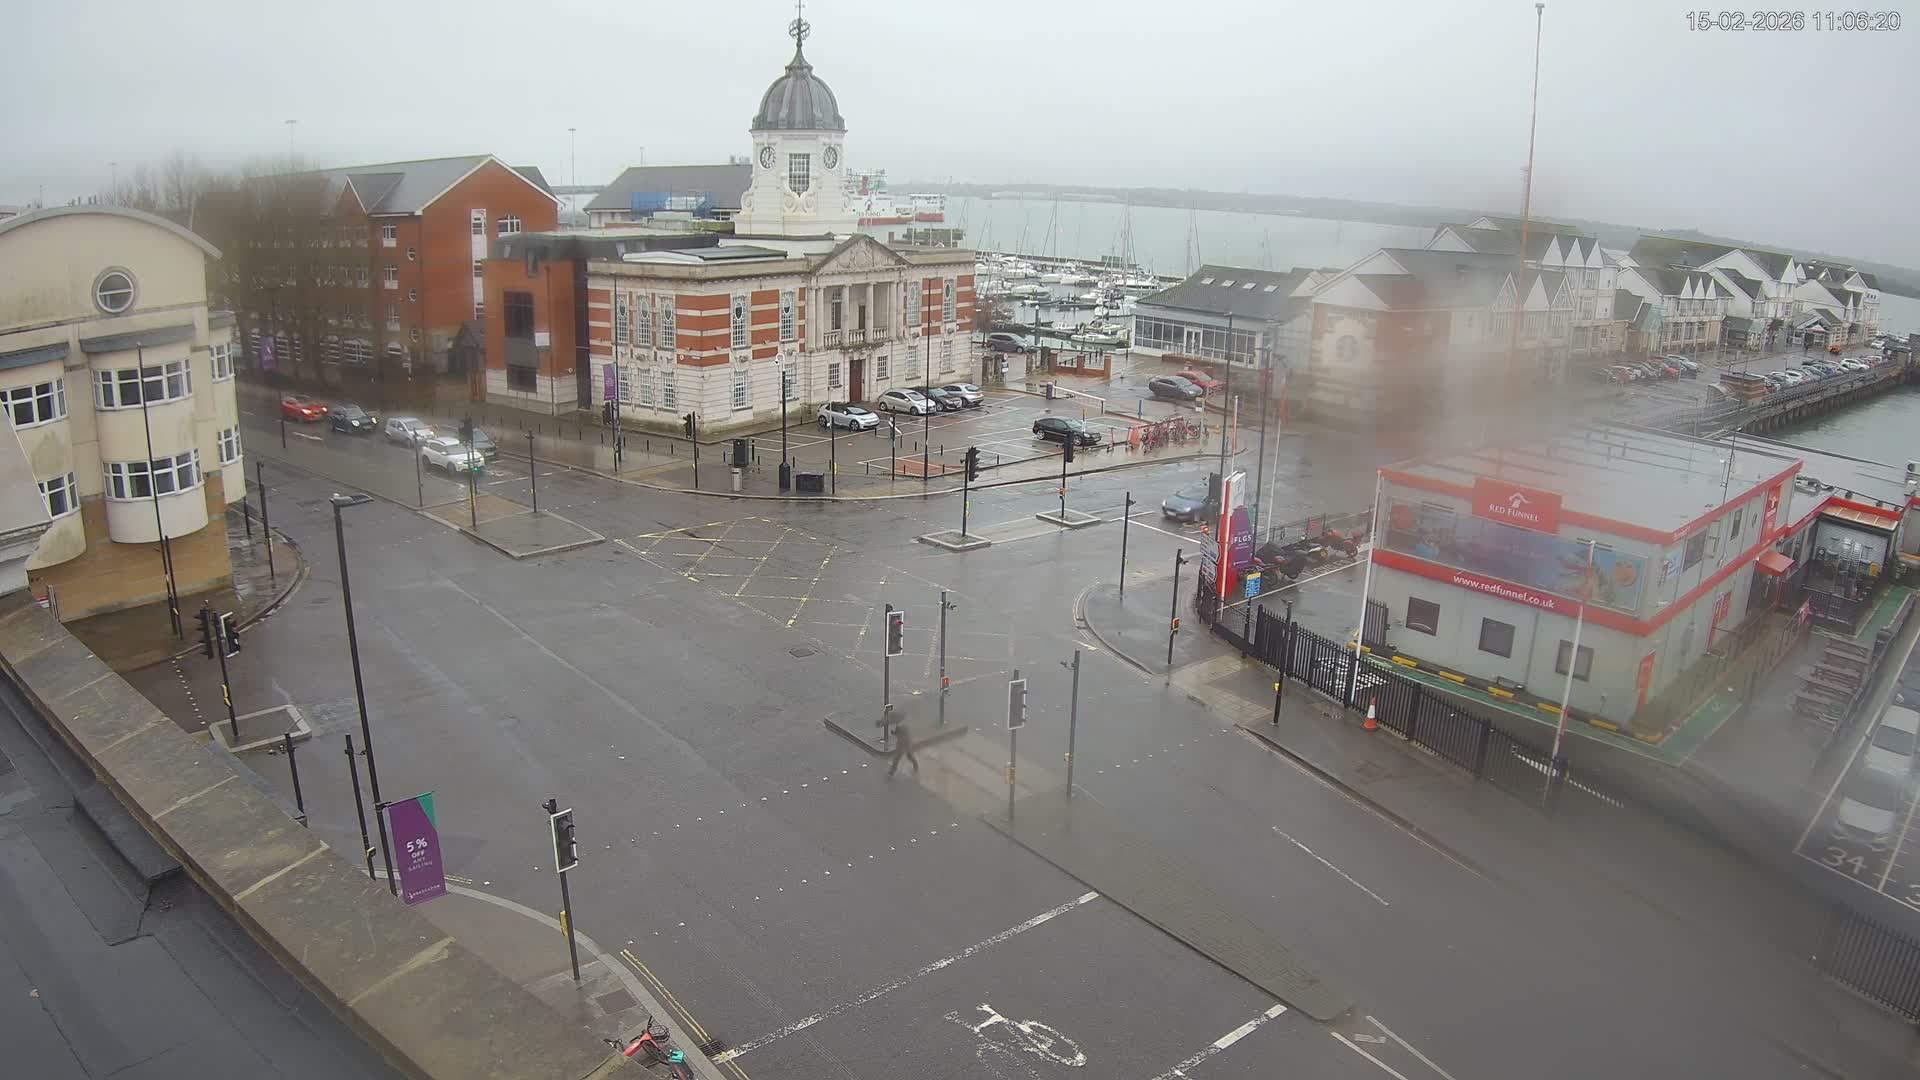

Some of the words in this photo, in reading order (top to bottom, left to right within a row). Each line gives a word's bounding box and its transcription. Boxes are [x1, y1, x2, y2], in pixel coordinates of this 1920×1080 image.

[1489, 503, 1506, 514] RED
[1507, 508, 1539, 522] FUNNEL
[1453, 574, 1555, 609] www.redfunnel.co.uk
[411, 849, 425, 859] OFF
[1821, 846, 1868, 875] 34
